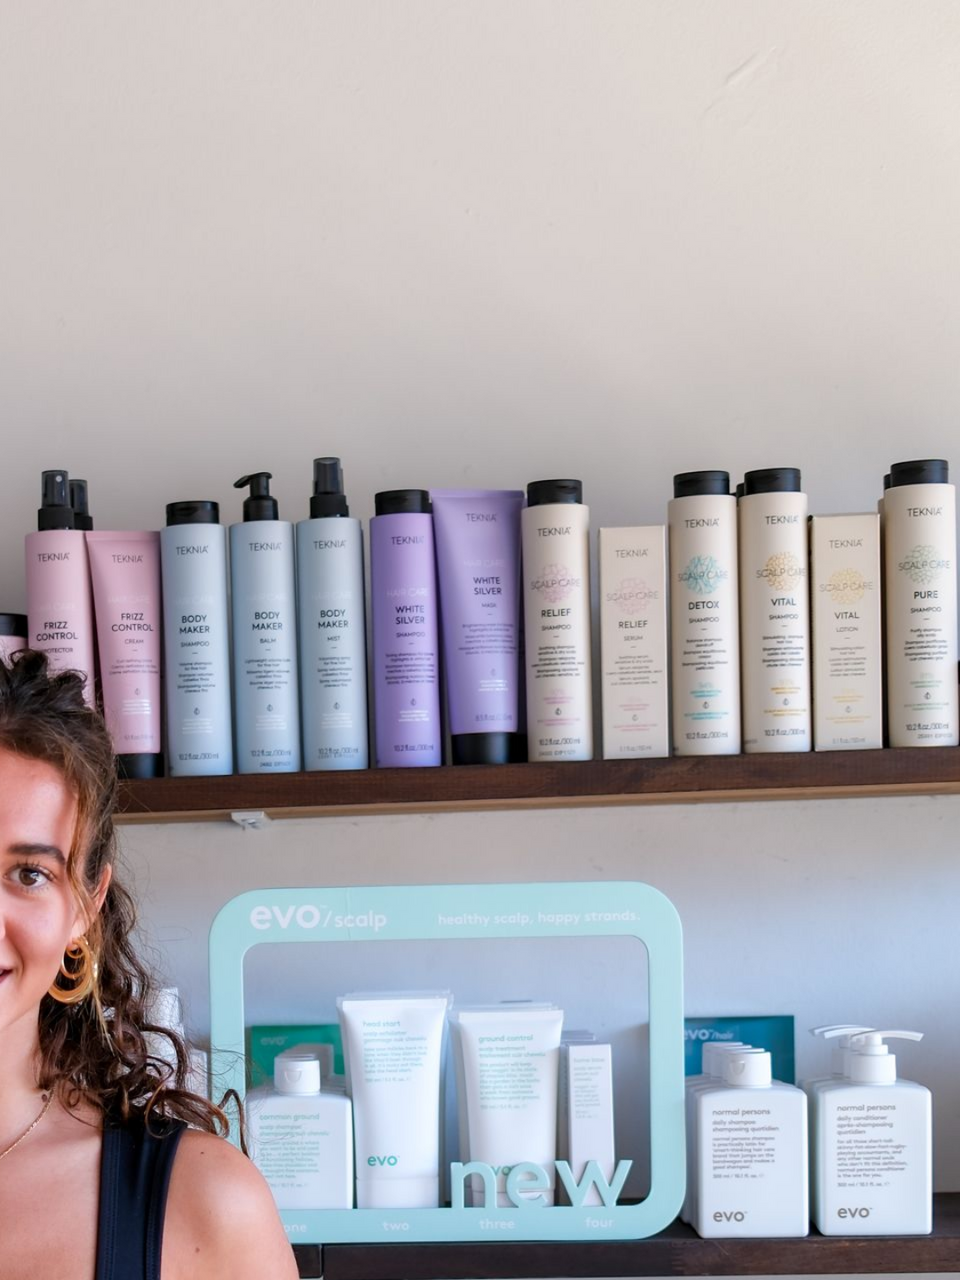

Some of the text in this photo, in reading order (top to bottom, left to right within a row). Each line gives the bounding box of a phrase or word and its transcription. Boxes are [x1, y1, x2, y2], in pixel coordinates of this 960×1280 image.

[907, 507, 942, 518] TEKNIA
[685, 518, 719, 528] TEKNIA
[765, 515, 799, 525] TEKNIA
[537, 527, 571, 537] TEKNIA
[391, 535, 424, 546] TEKNIA
[829, 539, 862, 549] TEKNIA
[176, 546, 209, 556] TEKNIA
[616, 548, 648, 558] TEKNIA
[38, 552, 70, 562] TEKNIA
[112, 554, 144, 564] TEKNIA
[473, 576, 500, 585] WHITE
[474, 587, 502, 595] SILVER
[914, 590, 938, 599] PURE
[688, 600, 719, 610] DETOX
[771, 597, 796, 607] VITAL
[320, 609, 346, 618] BODY
[395, 605, 425, 614] WHITE
[541, 608, 572, 618] RELIEF
[121, 612, 144, 621] FRIZZ
[181, 615, 207, 623] BODY
[254, 611, 280, 620] BODY
[396, 615, 425, 625] SILVER
[834, 612, 860, 620] VITAL
[43, 621, 68, 629] FRIZZ
[111, 623, 154, 632] CONTROL
[252, 622, 283, 631] MAKER
[318, 620, 348, 629] MAKER
[618, 620, 648, 630] RELIEF
[179, 626, 210, 634] MAKER
[36, 632, 78, 641] CONTROL
[438, 911, 641, 926] healthy scalp, happy strands.
[478, 1034, 533, 1043] ground control
[712, 1108, 770, 1116] normal persons
[837, 1104, 896, 1112] normal persons
[294, 1113, 320, 1121] ground
[368, 1155, 397, 1166] evo
[451, 1159, 633, 1208] new
[713, 1210, 745, 1222] evo
[837, 1206, 870, 1218] evo
[384, 1222, 409, 1231] two
[479, 1218, 515, 1229] three
[585, 1217, 614, 1228] four
